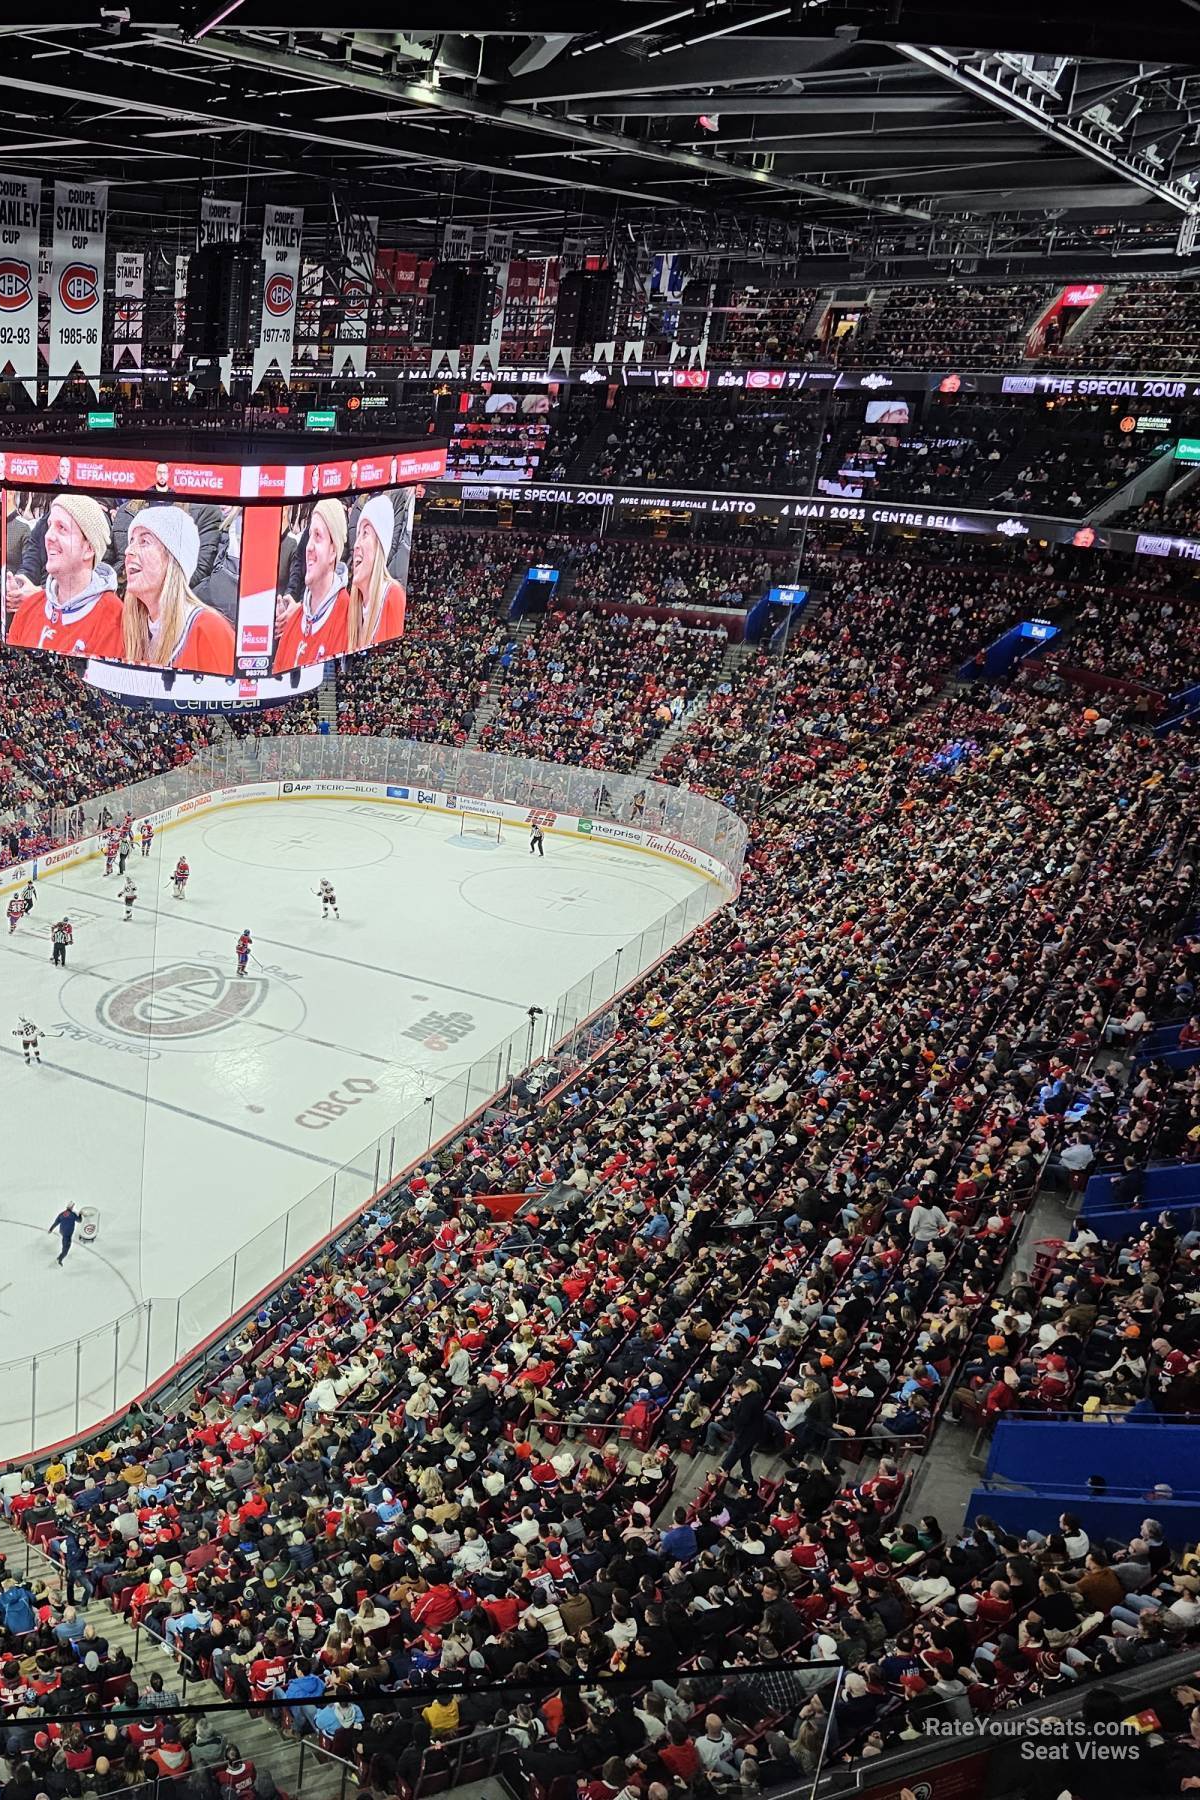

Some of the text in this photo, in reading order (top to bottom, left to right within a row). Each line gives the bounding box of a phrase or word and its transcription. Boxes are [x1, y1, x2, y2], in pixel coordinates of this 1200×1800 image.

[68, 188, 96, 205] COUPE
[209, 205, 231, 219] COUPE
[274, 211, 295, 225] COUPE
[56, 206, 106, 233] STANLEY
[2, 230, 21, 244] CUP
[200, 221, 239, 244] STANLEY
[265, 224, 300, 249] STANLEY
[72, 235, 89, 250] CUP
[123, 256, 137, 265] COUPE
[275, 250, 288, 263] CUP
[116, 265, 142, 280] STANLEY
[125, 280, 134, 288] CUP
[1068, 289, 1099, 304] Molson
[59, 327, 98, 345] 1985-86
[262, 328, 291, 343] 1977-78
[474, 371, 518, 382] CENTRE
[521, 371, 549, 383] BELL
[662, 376, 670, 384] 4
[677, 374, 685, 384] 0
[772, 375, 780, 384] 0
[1043, 377, 1078, 394] THE
[1079, 379, 1138, 395] SPECIAL
[10, 465, 39, 476] PRATT
[76, 470, 135, 484] LEFRANÇOIS
[174, 475, 223, 489] LORANGE
[260, 479, 285, 487] PRESSE
[496, 489, 520, 500] THE
[524, 490, 573, 503] SPECIAL
[620, 497, 637, 505] AVEC
[639, 498, 670, 506] INVITÉE
[672, 499, 707, 509] SPÉCIALE
[712, 501, 756, 513] LATTO
[780, 505, 957, 529] 4 MAI 2023 CENTRE BELL
[1032, 626, 1046, 637] Bell
[243, 636, 267, 644] PRESSE
[418, 791, 437, 804] Bell
[581, 822, 641, 841] enterprise
[646, 834, 663, 852] Tim
[663, 838, 697, 866] Hortons
[401, 1010, 451, 1042] MISE
[295, 1090, 362, 1130] CIBC
